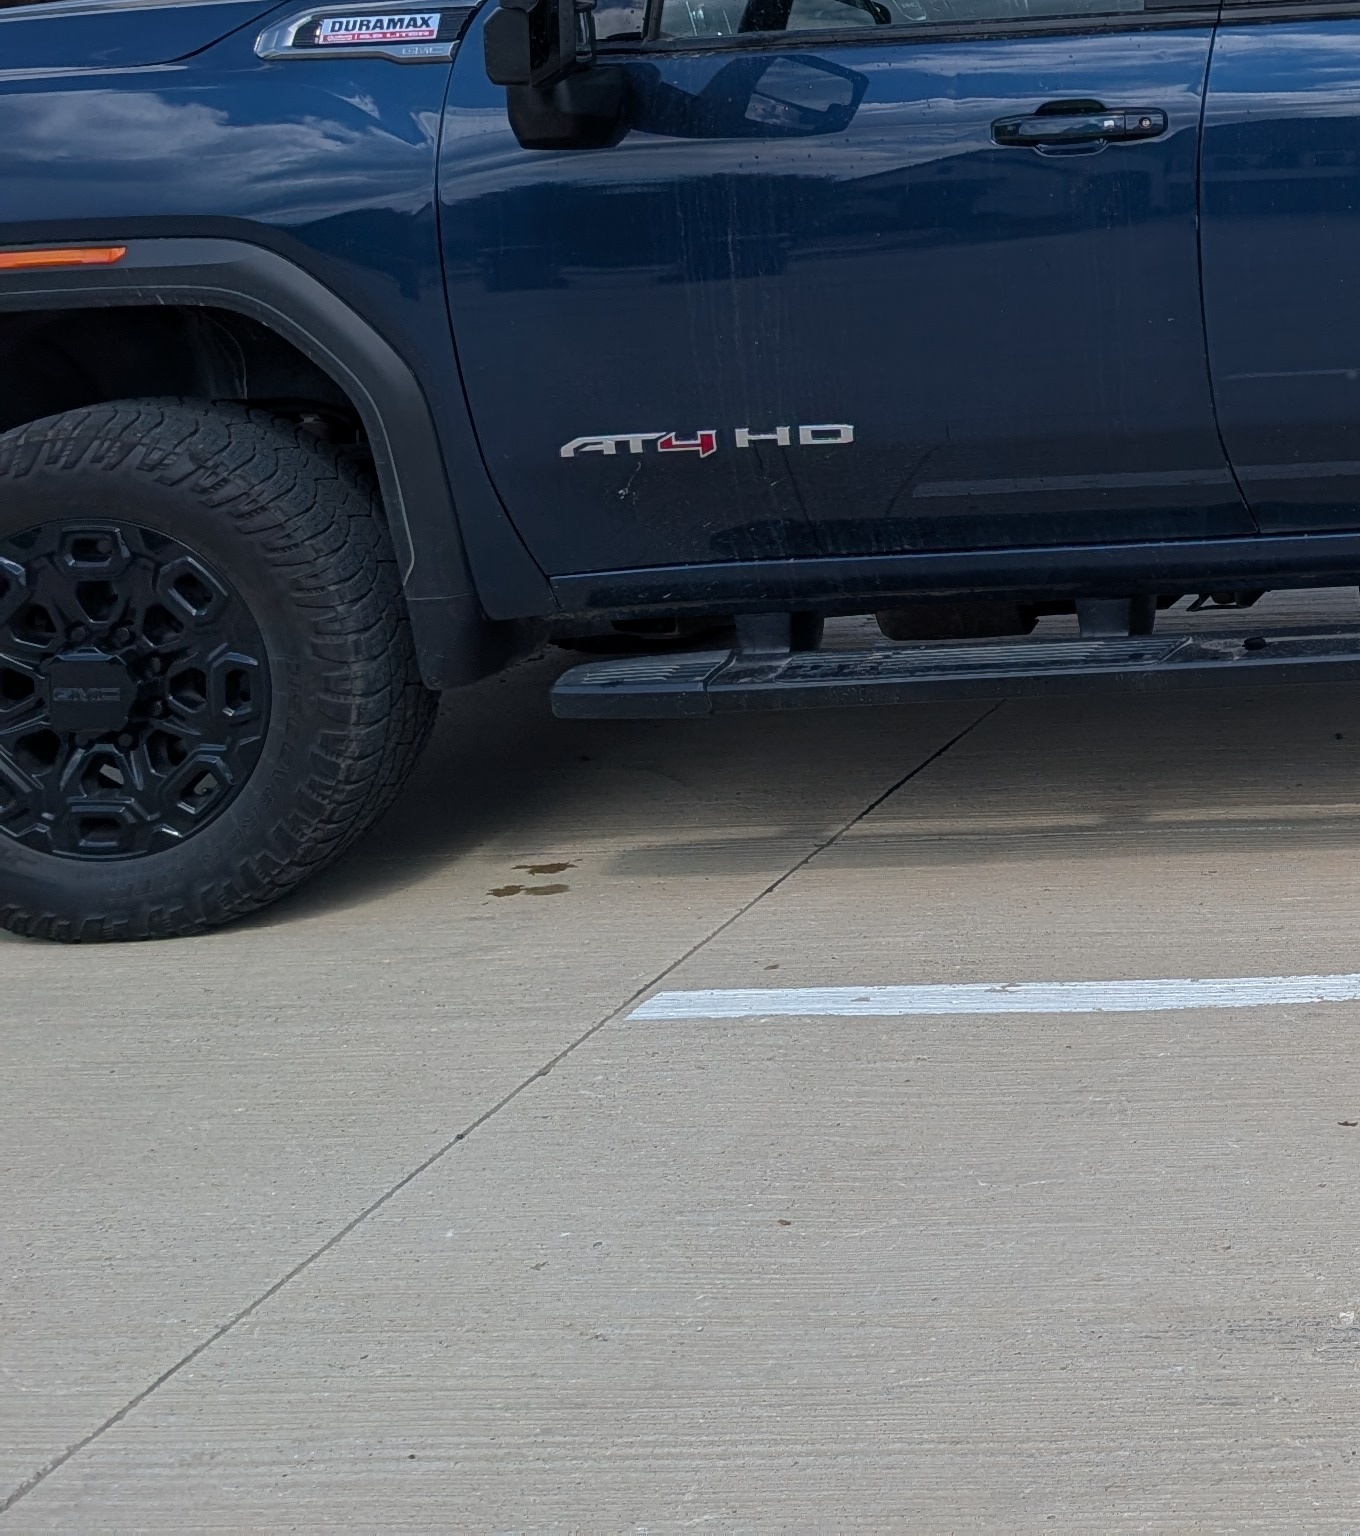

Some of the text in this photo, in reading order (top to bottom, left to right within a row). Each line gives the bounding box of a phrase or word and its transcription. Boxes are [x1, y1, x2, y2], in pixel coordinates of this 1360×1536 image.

[330, 16, 433, 32] DURAMAX
[560, 424, 854, 458] AT4 HD
[53, 687, 121, 702] GMC
